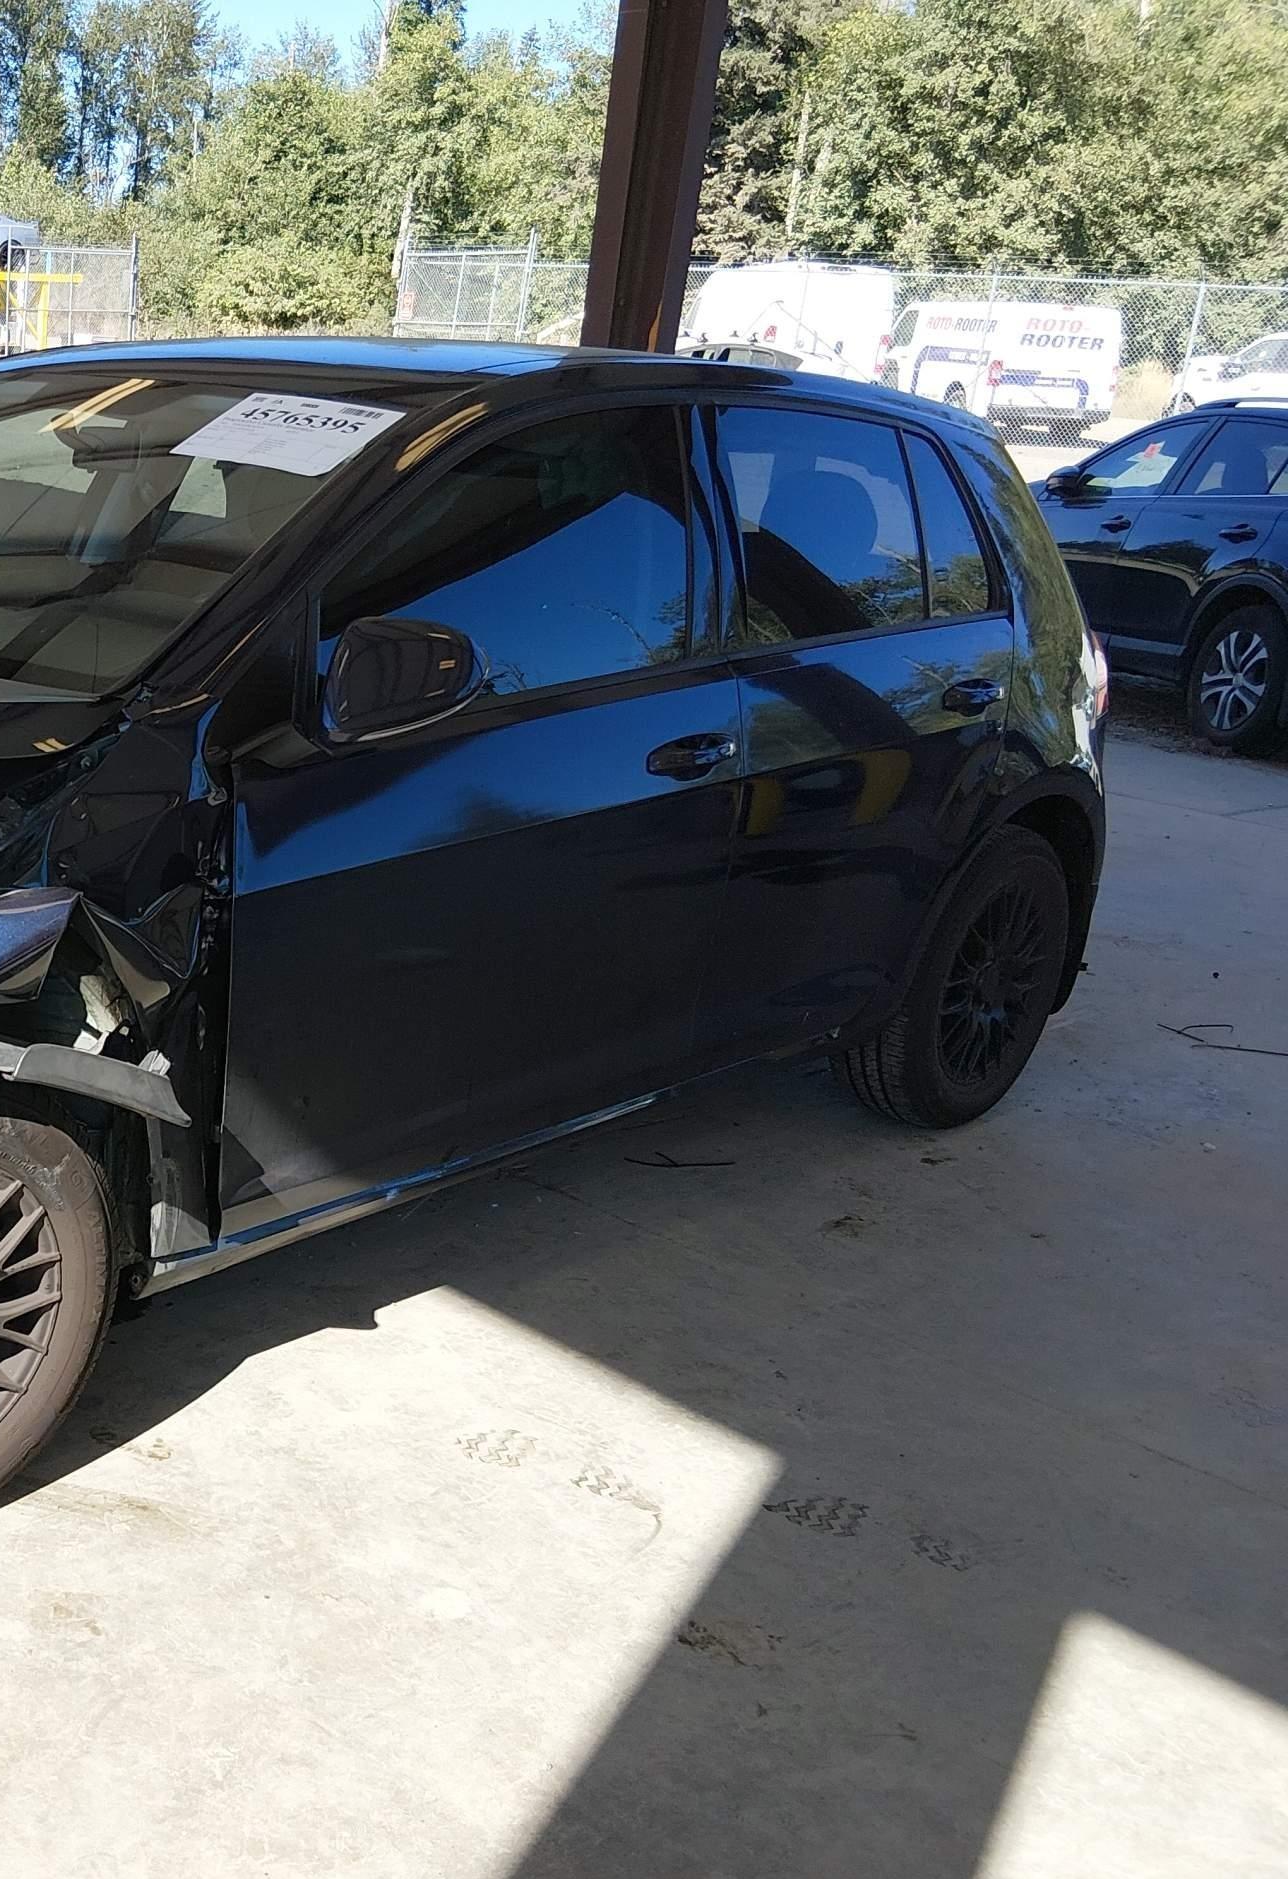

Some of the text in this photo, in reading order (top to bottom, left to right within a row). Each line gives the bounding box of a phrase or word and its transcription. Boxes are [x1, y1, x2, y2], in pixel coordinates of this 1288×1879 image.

[1026, 317, 1091, 333] ROTO-
[1020, 333, 1105, 351] ROOTER
[240, 407, 367, 433] 45765395
